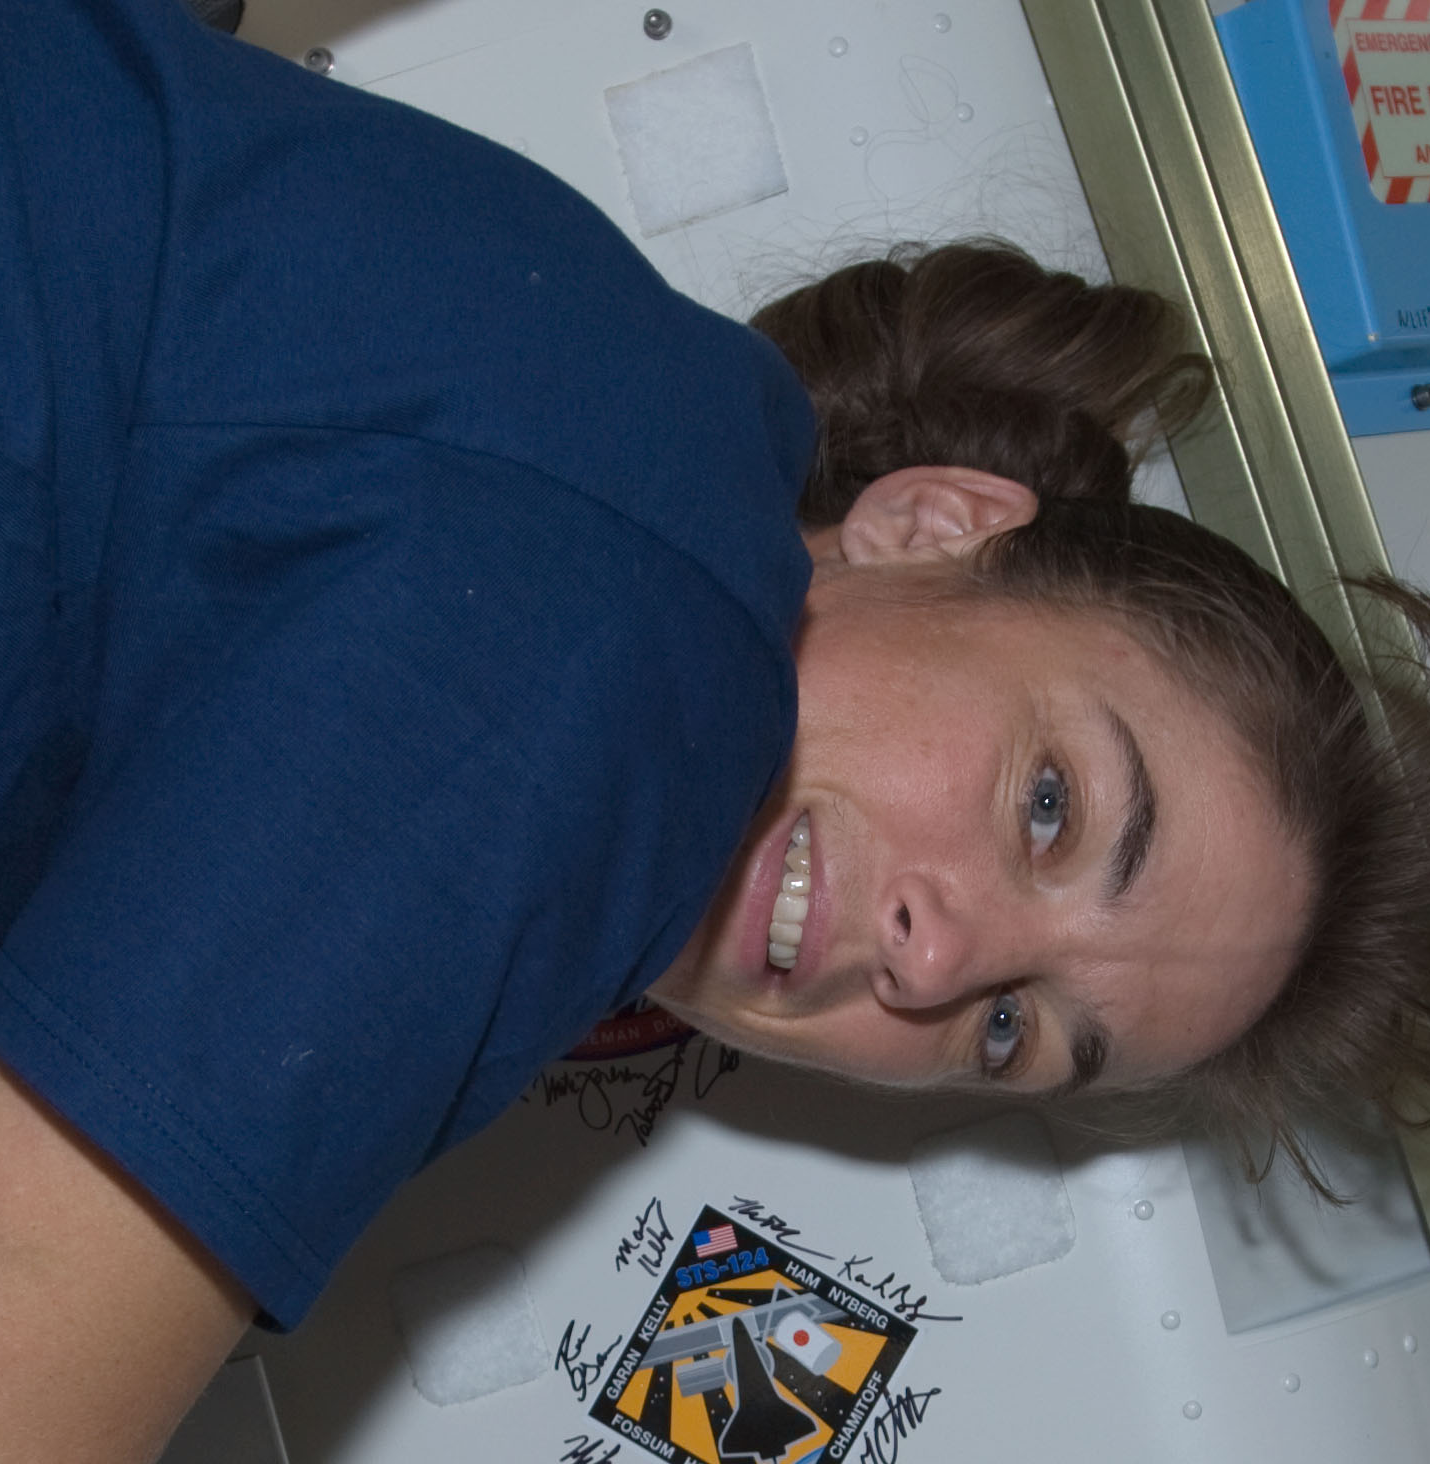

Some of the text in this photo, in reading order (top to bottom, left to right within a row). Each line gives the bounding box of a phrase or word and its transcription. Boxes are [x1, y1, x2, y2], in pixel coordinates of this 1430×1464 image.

[1369, 86, 1426, 116] FIRE
[675, 1246, 770, 1290] STS-124
[784, 1260, 822, 1291] HAM
[827, 1286, 890, 1331] NYBERG
[605, 1294, 671, 1402] GARAN KELLY
[610, 1412, 675, 1460] FOSSUM
[828, 1370, 886, 1461] CHAMITOFF
